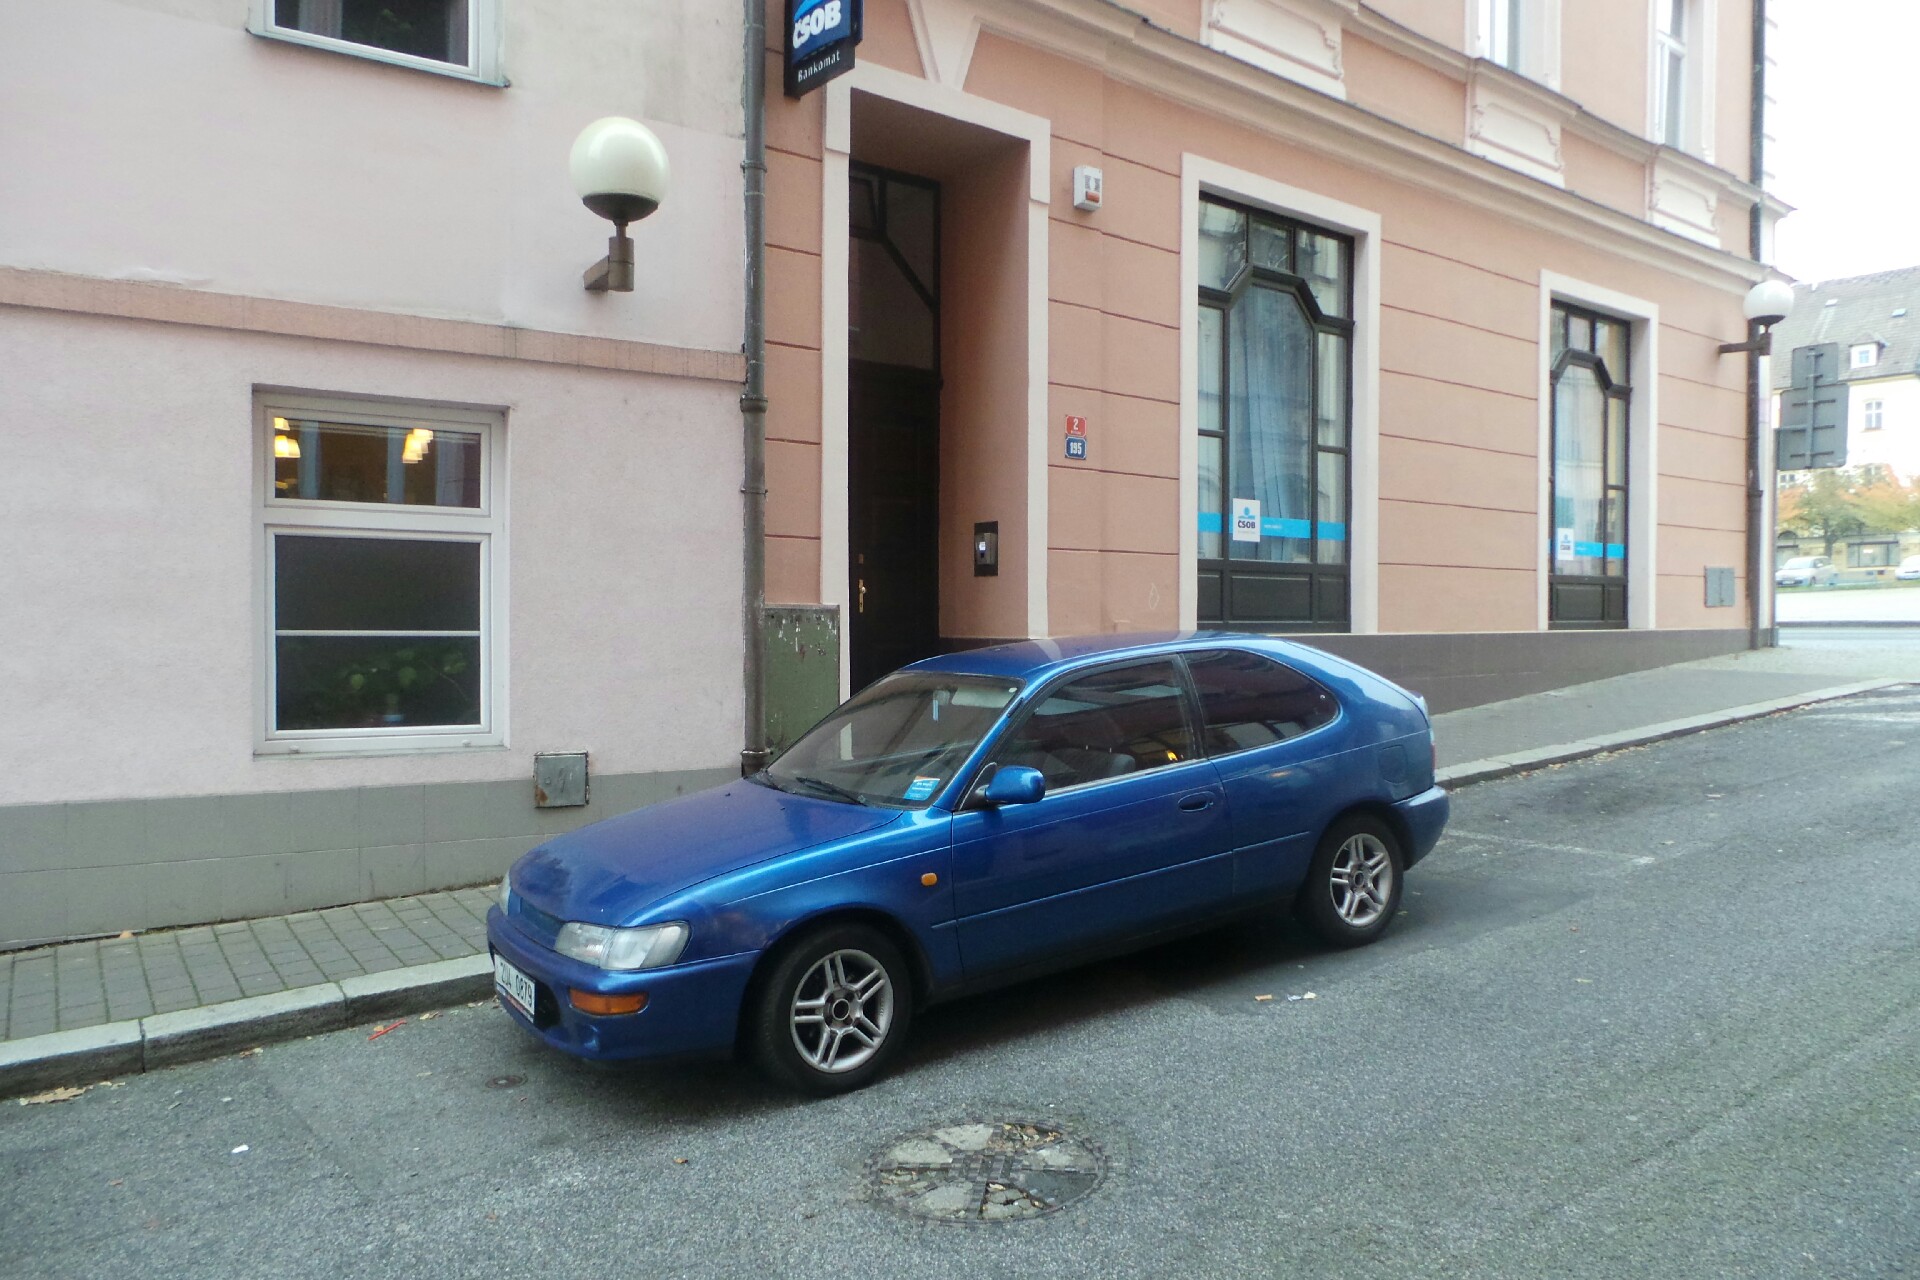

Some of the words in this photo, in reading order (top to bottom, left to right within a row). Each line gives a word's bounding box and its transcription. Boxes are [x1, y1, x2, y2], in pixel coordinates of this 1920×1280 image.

[797, 49, 841, 83] Bankomat
[1073, 417, 1079, 431] 2
[1070, 442, 1082, 455] 195
[1237, 518, 1256, 529] ČSOB
